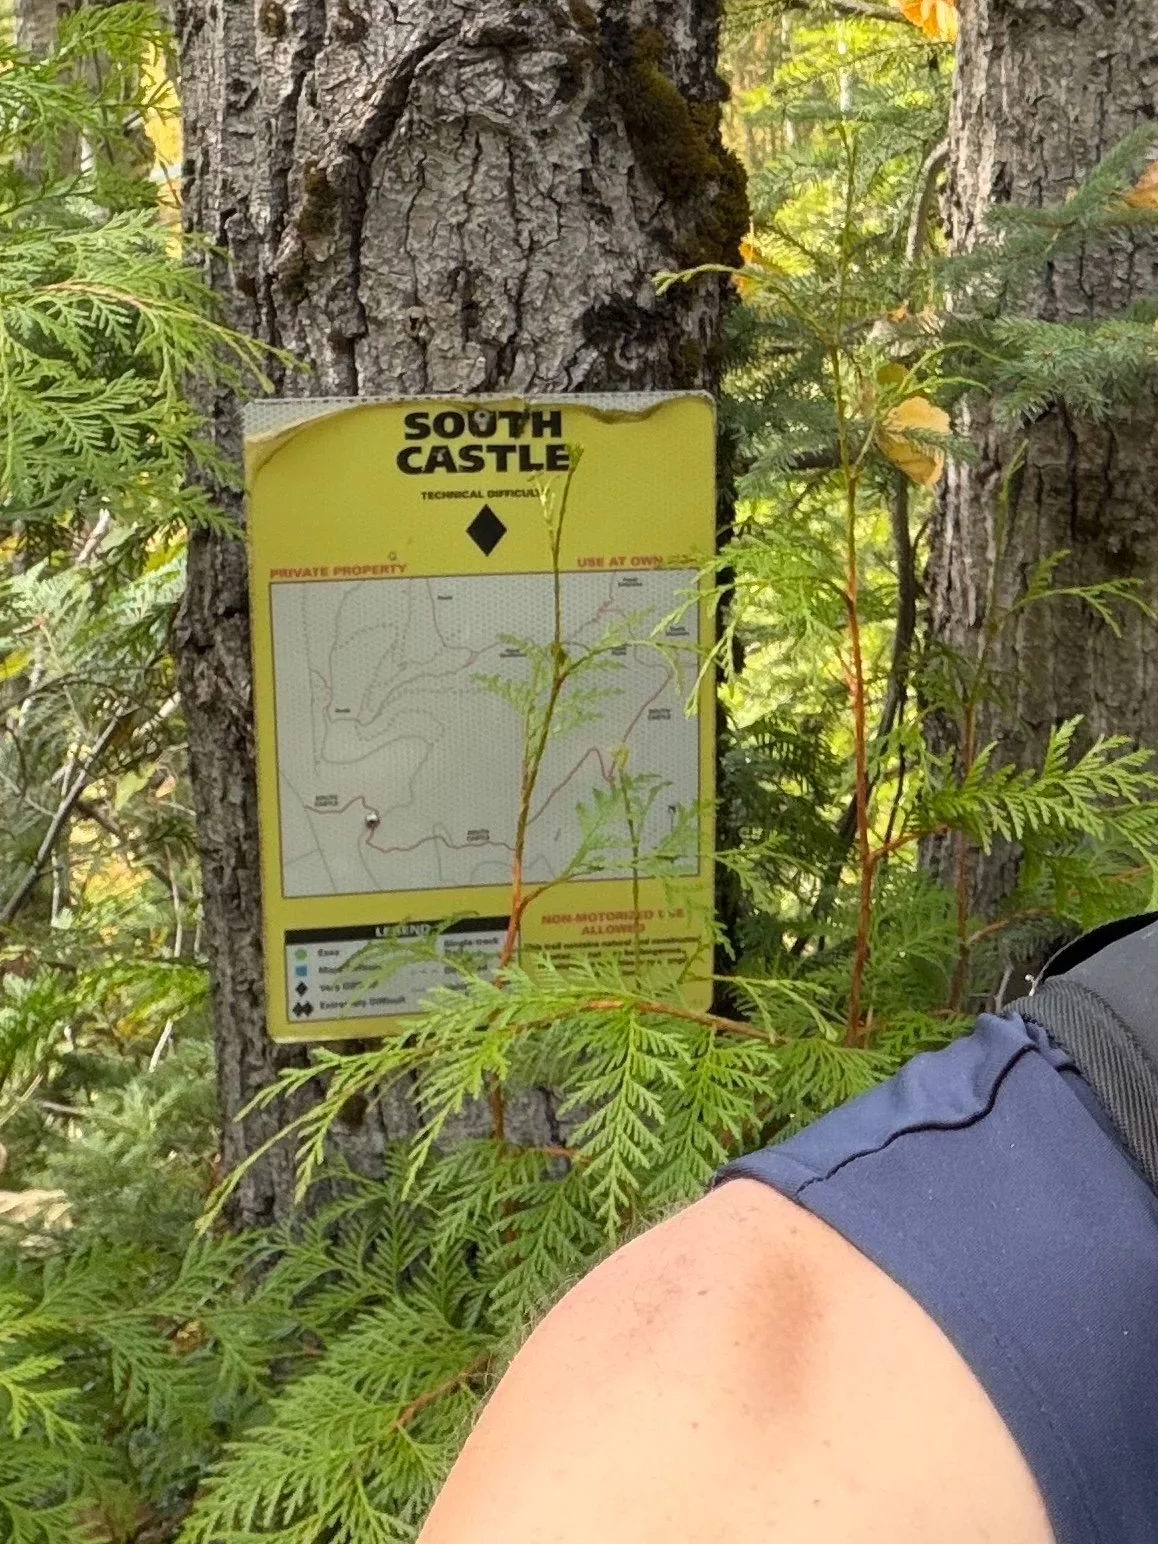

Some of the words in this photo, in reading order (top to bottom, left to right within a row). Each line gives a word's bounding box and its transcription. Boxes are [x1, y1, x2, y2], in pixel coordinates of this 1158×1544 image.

[404, 410, 562, 440] SOUTH
[396, 444, 571, 475] CASTLE
[421, 489, 484, 500] TECHNICAL
[487, 488, 548, 498] DIFFICULT
[577, 557, 604, 568] USE
[609, 556, 625, 566] AT
[630, 555, 663, 566] OWN
[270, 566, 329, 579] PRIVATE
[333, 563, 407, 576] PROPERTY
[541, 909, 654, 924] NON-MOTORIZED
[375, 924, 431, 937] LEEND
[582, 923, 646, 935] ALLOWED
